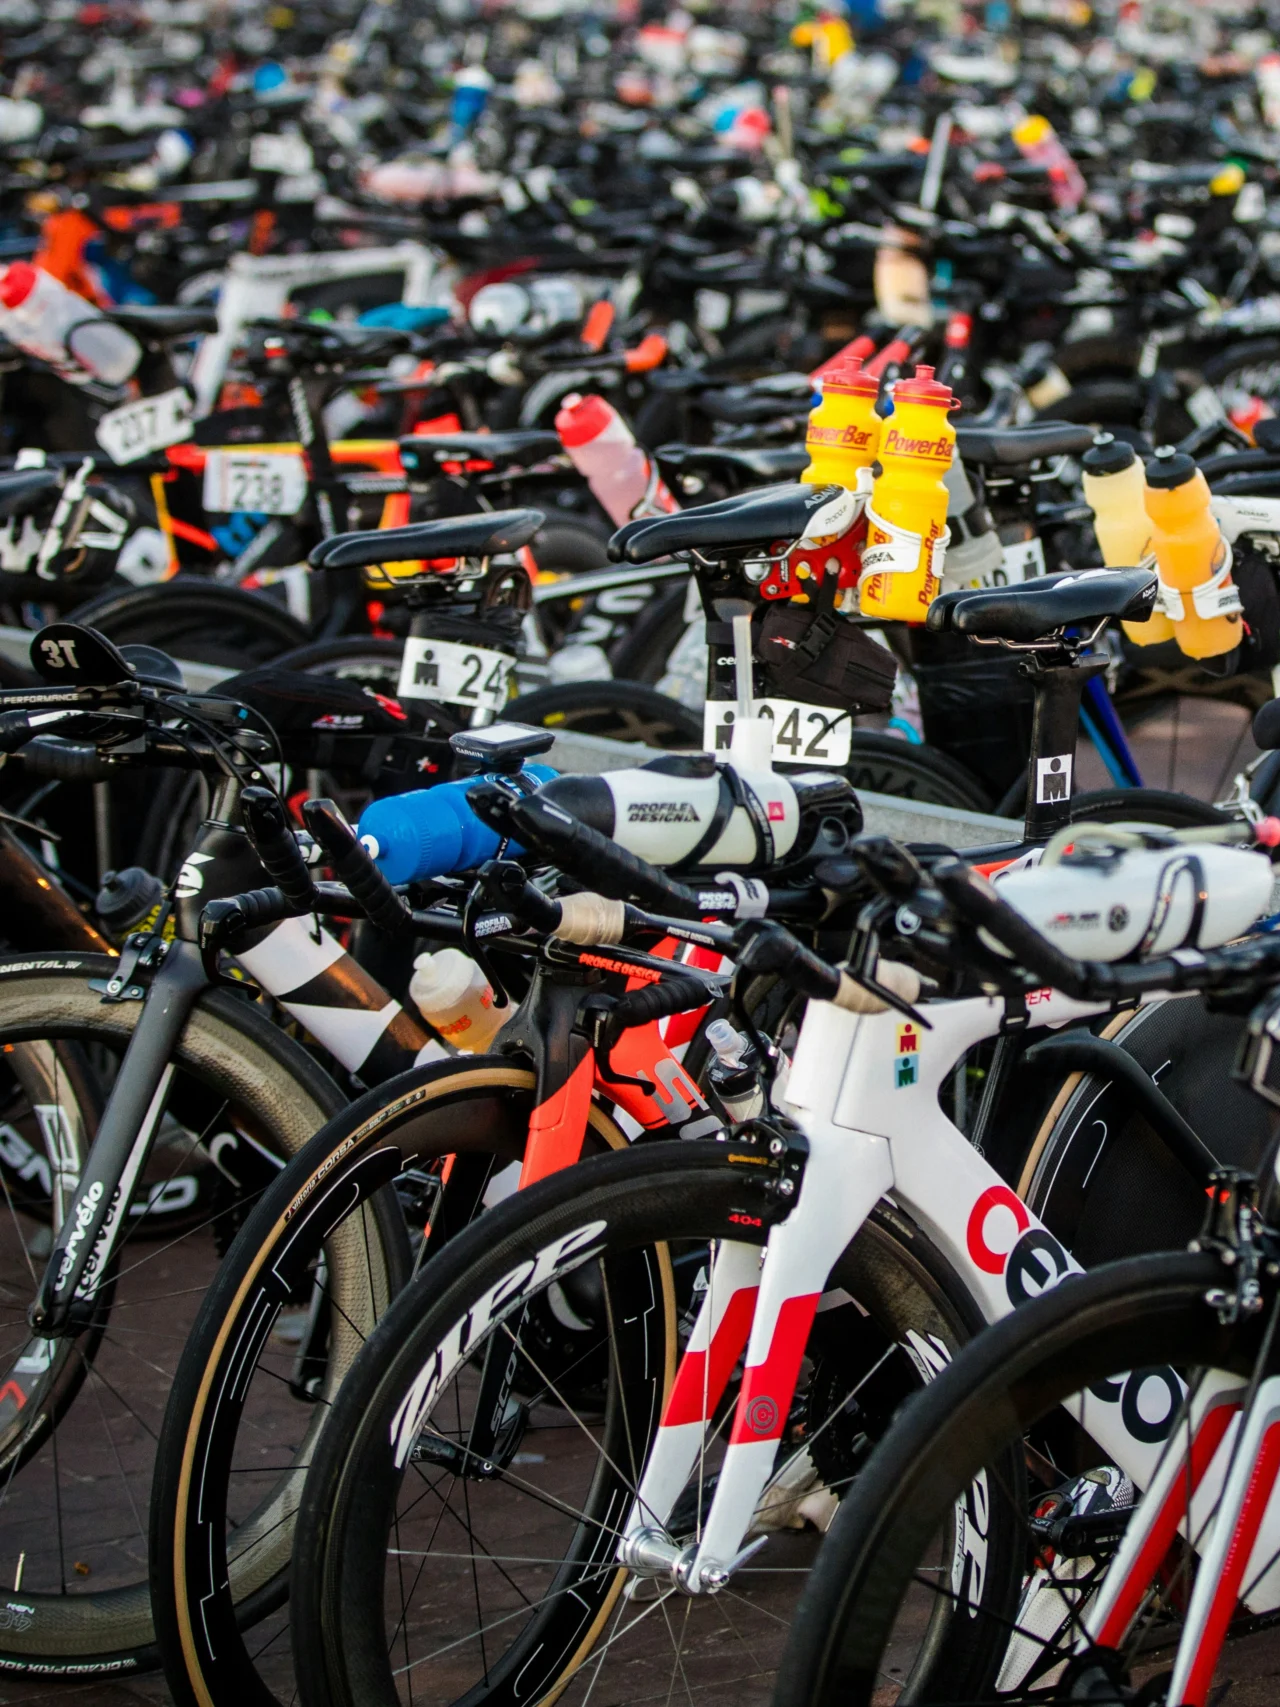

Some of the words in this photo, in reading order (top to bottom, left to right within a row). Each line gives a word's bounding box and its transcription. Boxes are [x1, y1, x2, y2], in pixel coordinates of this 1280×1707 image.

[884, 429, 955, 457] PowerBa
[40, 639, 80, 669] 3T
[455, 747, 484, 759] GARMIN
[628, 803, 687, 813] PROFILE
[628, 812, 686, 823] DESIGN
[699, 900, 736, 909] DESIG
[0, 960, 64, 973] NENTAL
[579, 952, 621, 973] PROFILE
[621, 963, 662, 983] DESIGN
[318, 1138, 355, 1180] CORSA
[728, 1214, 762, 1227] 404
[54, 1180, 104, 1291] cervélo
[390, 1219, 608, 1469] ZIPP
